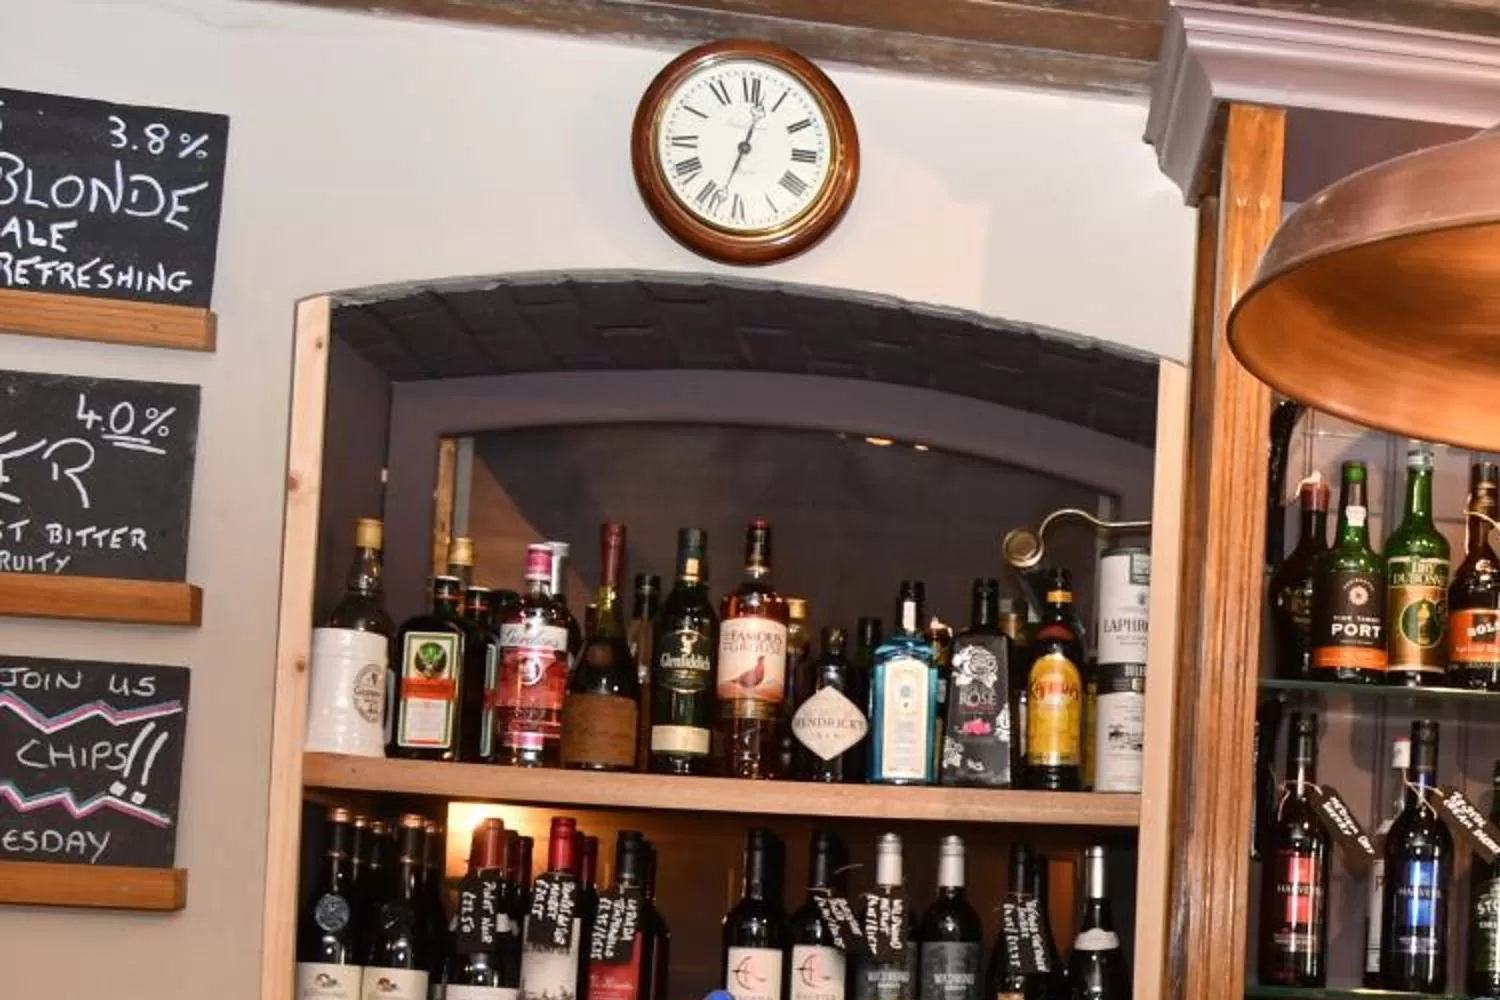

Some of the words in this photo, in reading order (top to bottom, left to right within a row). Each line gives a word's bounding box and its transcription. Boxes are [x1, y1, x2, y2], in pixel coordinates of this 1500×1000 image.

[108, 115, 209, 159] 3.8%
[0, 151, 209, 231] BLONDE
[0, 216, 78, 252] ALE
[0, 251, 193, 292] REFRESHING
[77, 393, 177, 437] 4.0%
[45, 523, 148, 551] BITTER
[1331, 623, 1382, 637] PORT
[0, 667, 81, 690] JOIN
[108, 673, 157, 697] US
